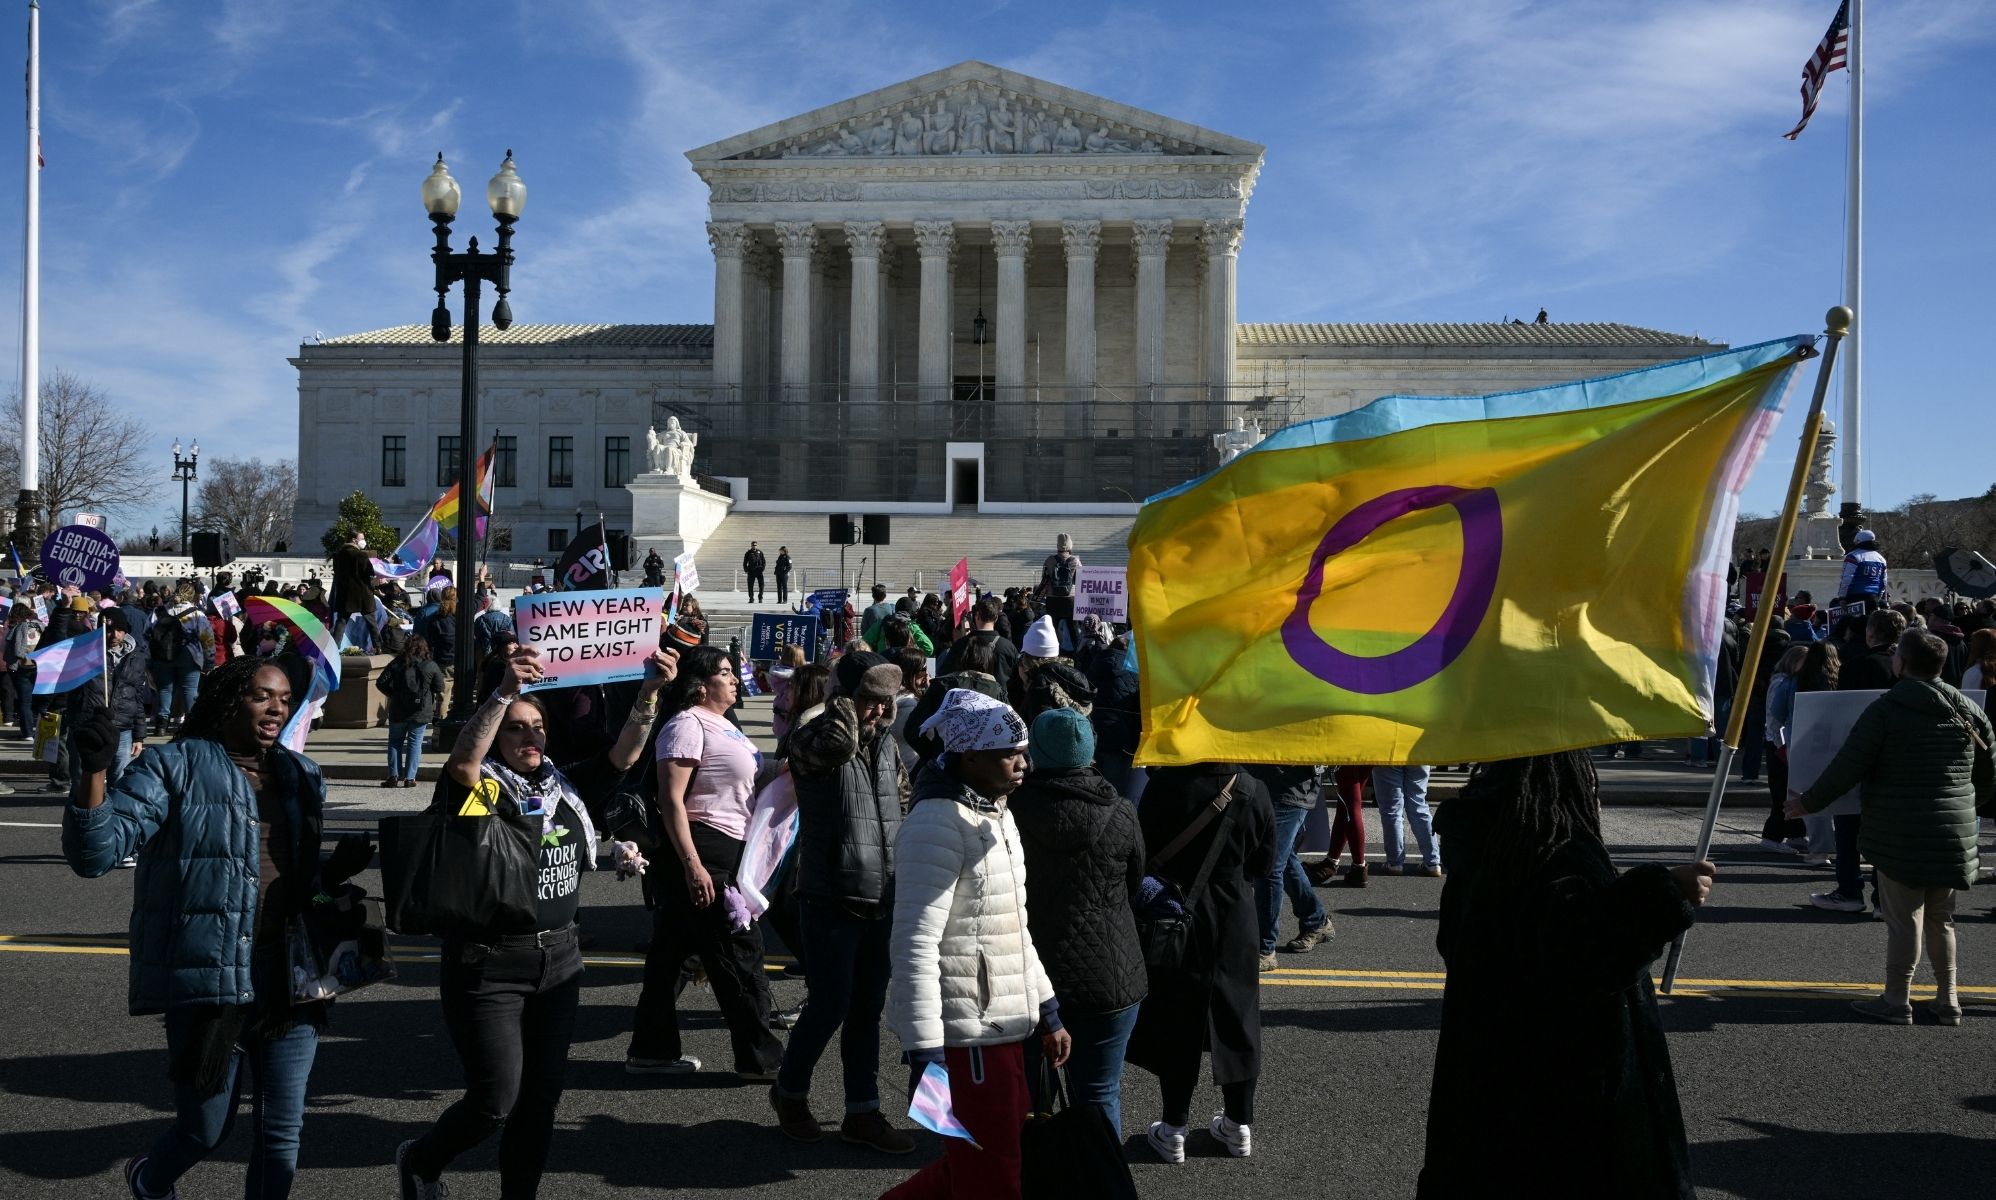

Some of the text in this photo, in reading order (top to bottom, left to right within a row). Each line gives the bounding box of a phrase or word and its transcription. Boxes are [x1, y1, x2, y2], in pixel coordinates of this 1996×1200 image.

[85, 517, 97, 526] NO
[56, 530, 117, 559] LGBTQIA+
[50, 545, 112, 576] EQUALITY
[1080, 580, 1122, 595] FEMALE
[531, 597, 650, 619] NEW YEAR,
[1076, 606, 1124, 617] HORMONE LEVEL
[1832, 605, 1862, 617] PROECT
[529, 618, 653, 642] SAME FIGHT
[774, 623, 785, 653] VOTE
[547, 641, 636, 663] TO EXIST.
[546, 843, 577, 866] YORK
[557, 872, 579, 897] GRO
